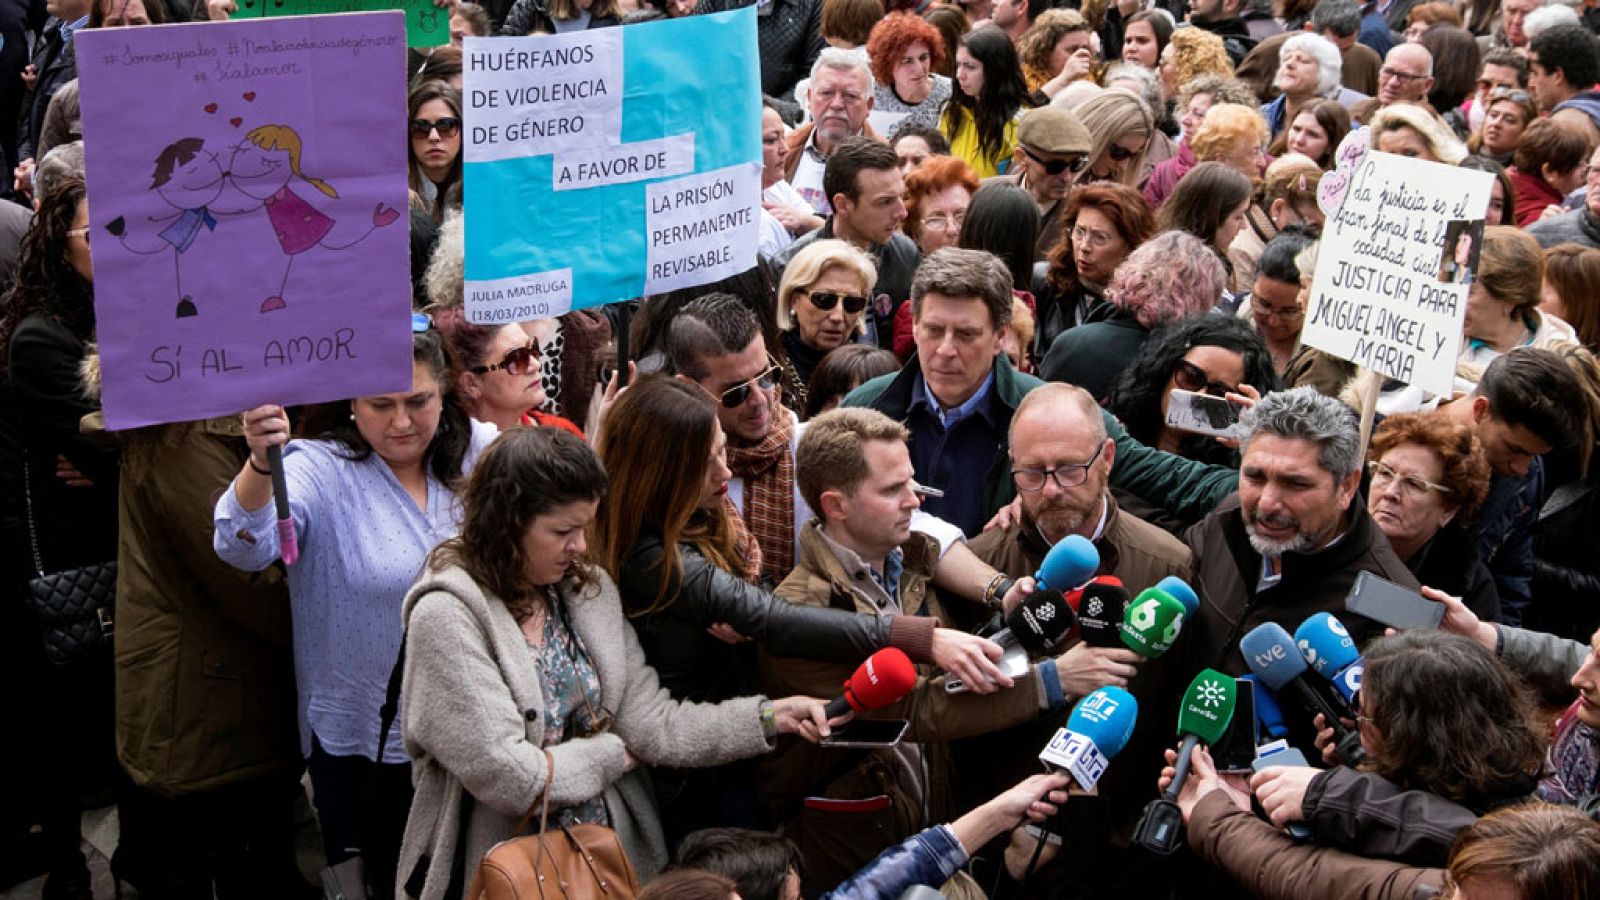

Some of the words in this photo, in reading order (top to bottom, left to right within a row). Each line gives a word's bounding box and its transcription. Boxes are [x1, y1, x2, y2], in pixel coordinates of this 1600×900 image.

[471, 44, 594, 72] HUÉRFANOS
[471, 90, 499, 108] DE
[505, 78, 607, 106] VIOLENCIA
[472, 126, 498, 144] DE
[505, 115, 584, 142] GÉNERO
[558, 166, 573, 183] A
[577, 156, 639, 181] FAVOR
[645, 151, 667, 171] DE
[652, 196, 672, 214] LA
[675, 178, 735, 209] PRISIÓN
[1354, 160, 1376, 202] La
[1378, 180, 1428, 215] justicia
[1432, 198, 1448, 215] es
[1452, 193, 1470, 219] el
[653, 206, 752, 247] PERMANENTE
[1413, 218, 1429, 243] de
[652, 245, 734, 280] REVISABLE.
[1352, 238, 1407, 268] sociedad
[471, 289, 504, 302] JULIA
[507, 280, 567, 299] MADRUGA
[1332, 260, 1413, 301] JUSTICIA
[1416, 284, 1459, 318] PARA
[471, 302, 550, 322] (18/03/2010)
[201, 348, 244, 377] AL
[263, 327, 359, 368] AMOR
[1350, 337, 1416, 385] MARIA
[1432, 331, 1447, 361] Y
[1254, 643, 1287, 668] tve
